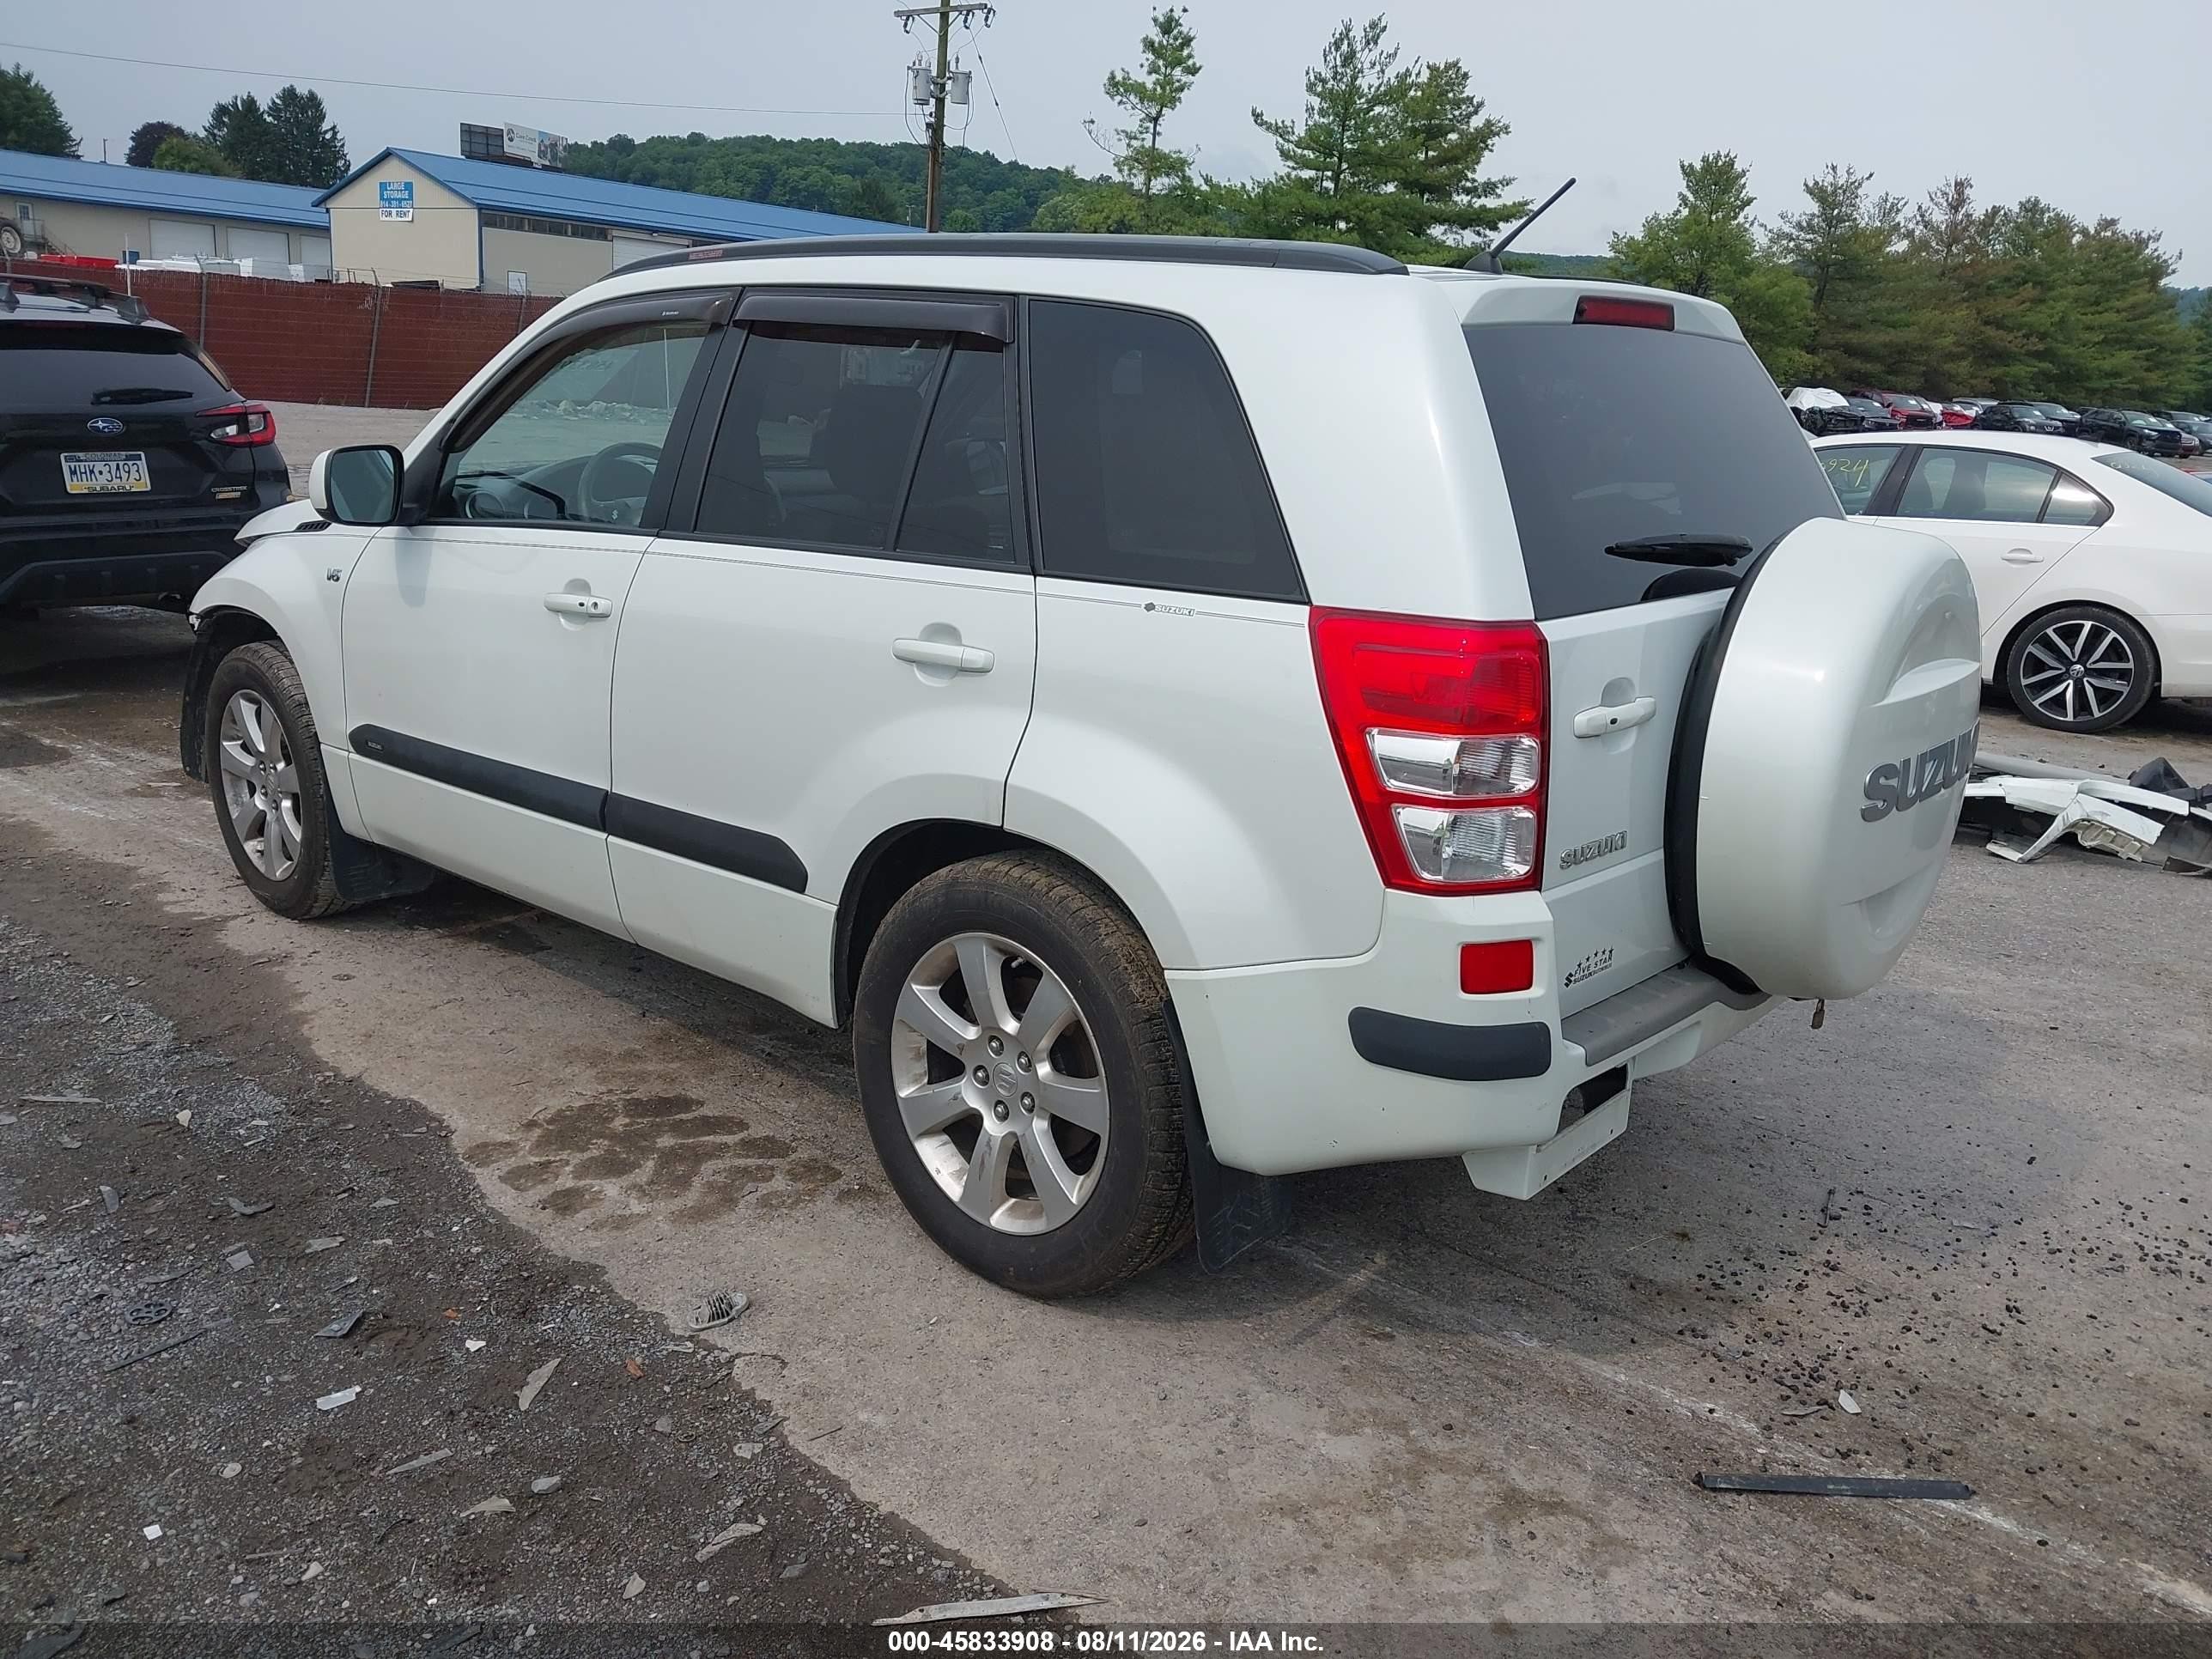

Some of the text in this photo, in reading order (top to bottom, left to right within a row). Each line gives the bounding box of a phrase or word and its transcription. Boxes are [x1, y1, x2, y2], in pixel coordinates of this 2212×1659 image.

[386, 181, 404, 190] LARGE
[380, 210, 410, 218] FOR RENT
[87, 484, 132, 493] SUBARU
[326, 568, 342, 582] V6
[1155, 604, 1195, 617] SUZUKI
[1861, 718, 1980, 823] SUZUK
[1559, 830, 1628, 870] SUZUKI
[1573, 963, 1592, 978] FIVE
